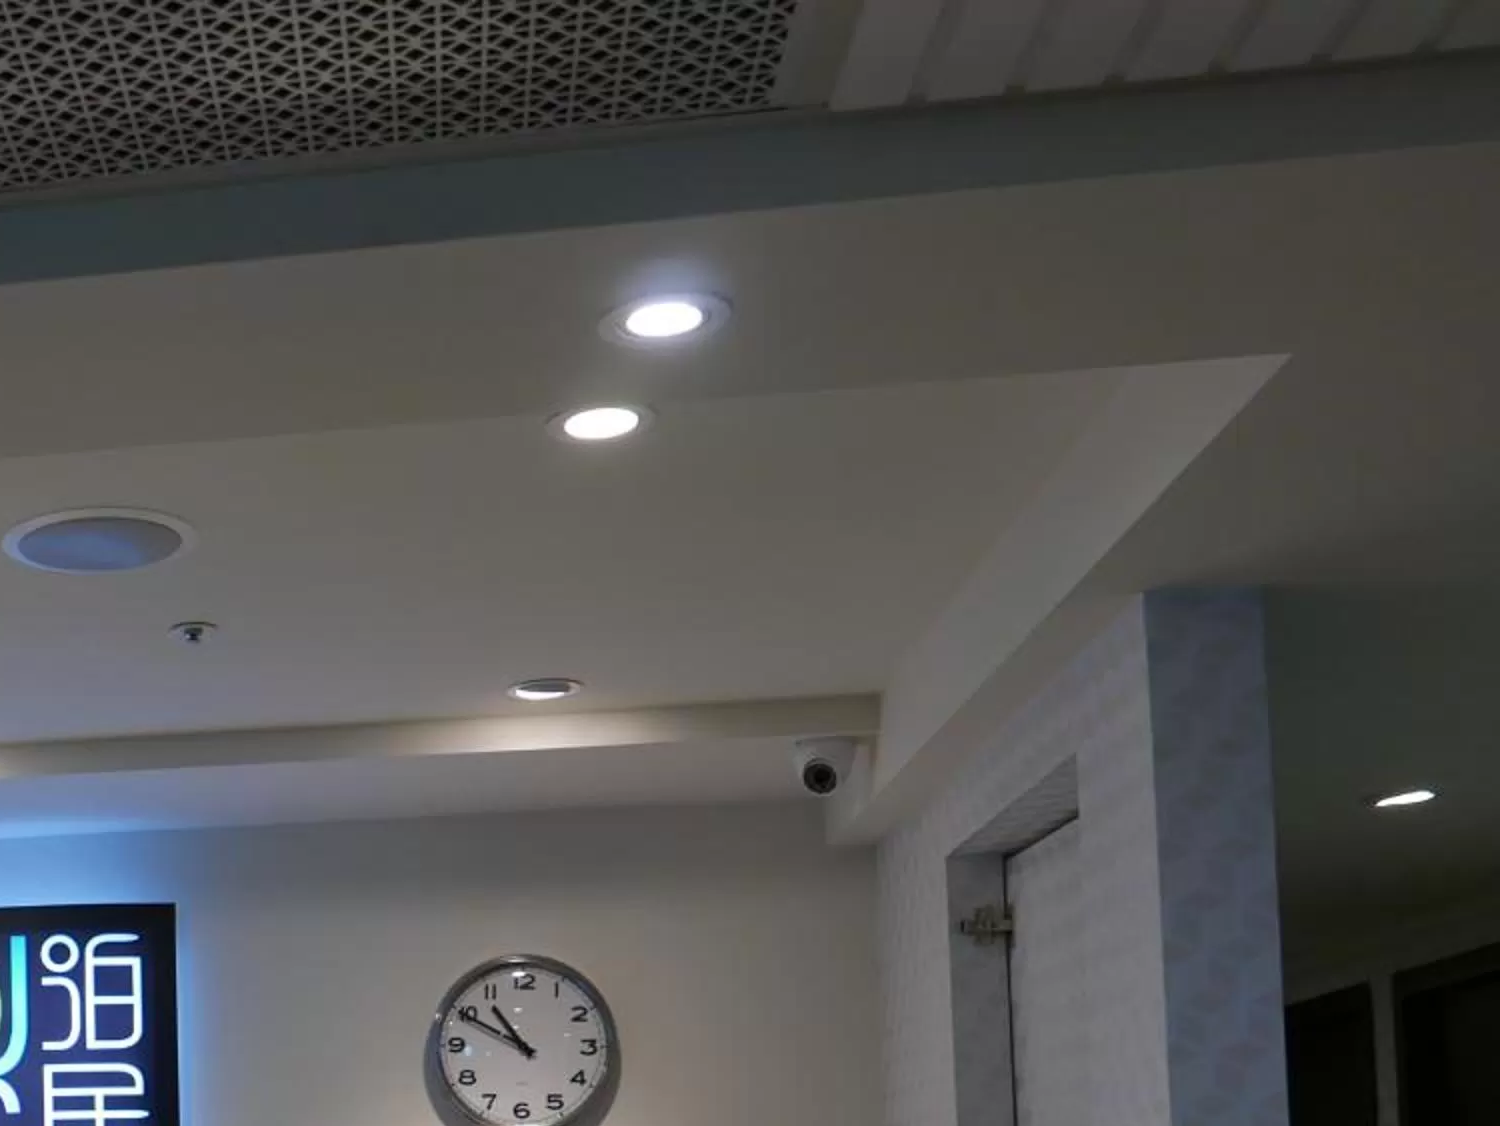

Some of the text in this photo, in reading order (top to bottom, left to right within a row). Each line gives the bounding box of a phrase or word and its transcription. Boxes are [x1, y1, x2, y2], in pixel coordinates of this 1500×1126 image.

[513, 974, 536, 991] 12
[553, 982, 560, 999] 1
[484, 983, 497, 1000] 11
[458, 1005, 478, 1022] 10
[570, 1006, 589, 1023] 2
[448, 1037, 465, 1053] 9
[580, 1039, 597, 1056] 3
[458, 1069, 477, 1086] 8
[570, 1069, 587, 1086] 4
[481, 1094, 497, 1110] 7
[547, 1094, 565, 1111] 5
[513, 1103, 531, 1120] 6
